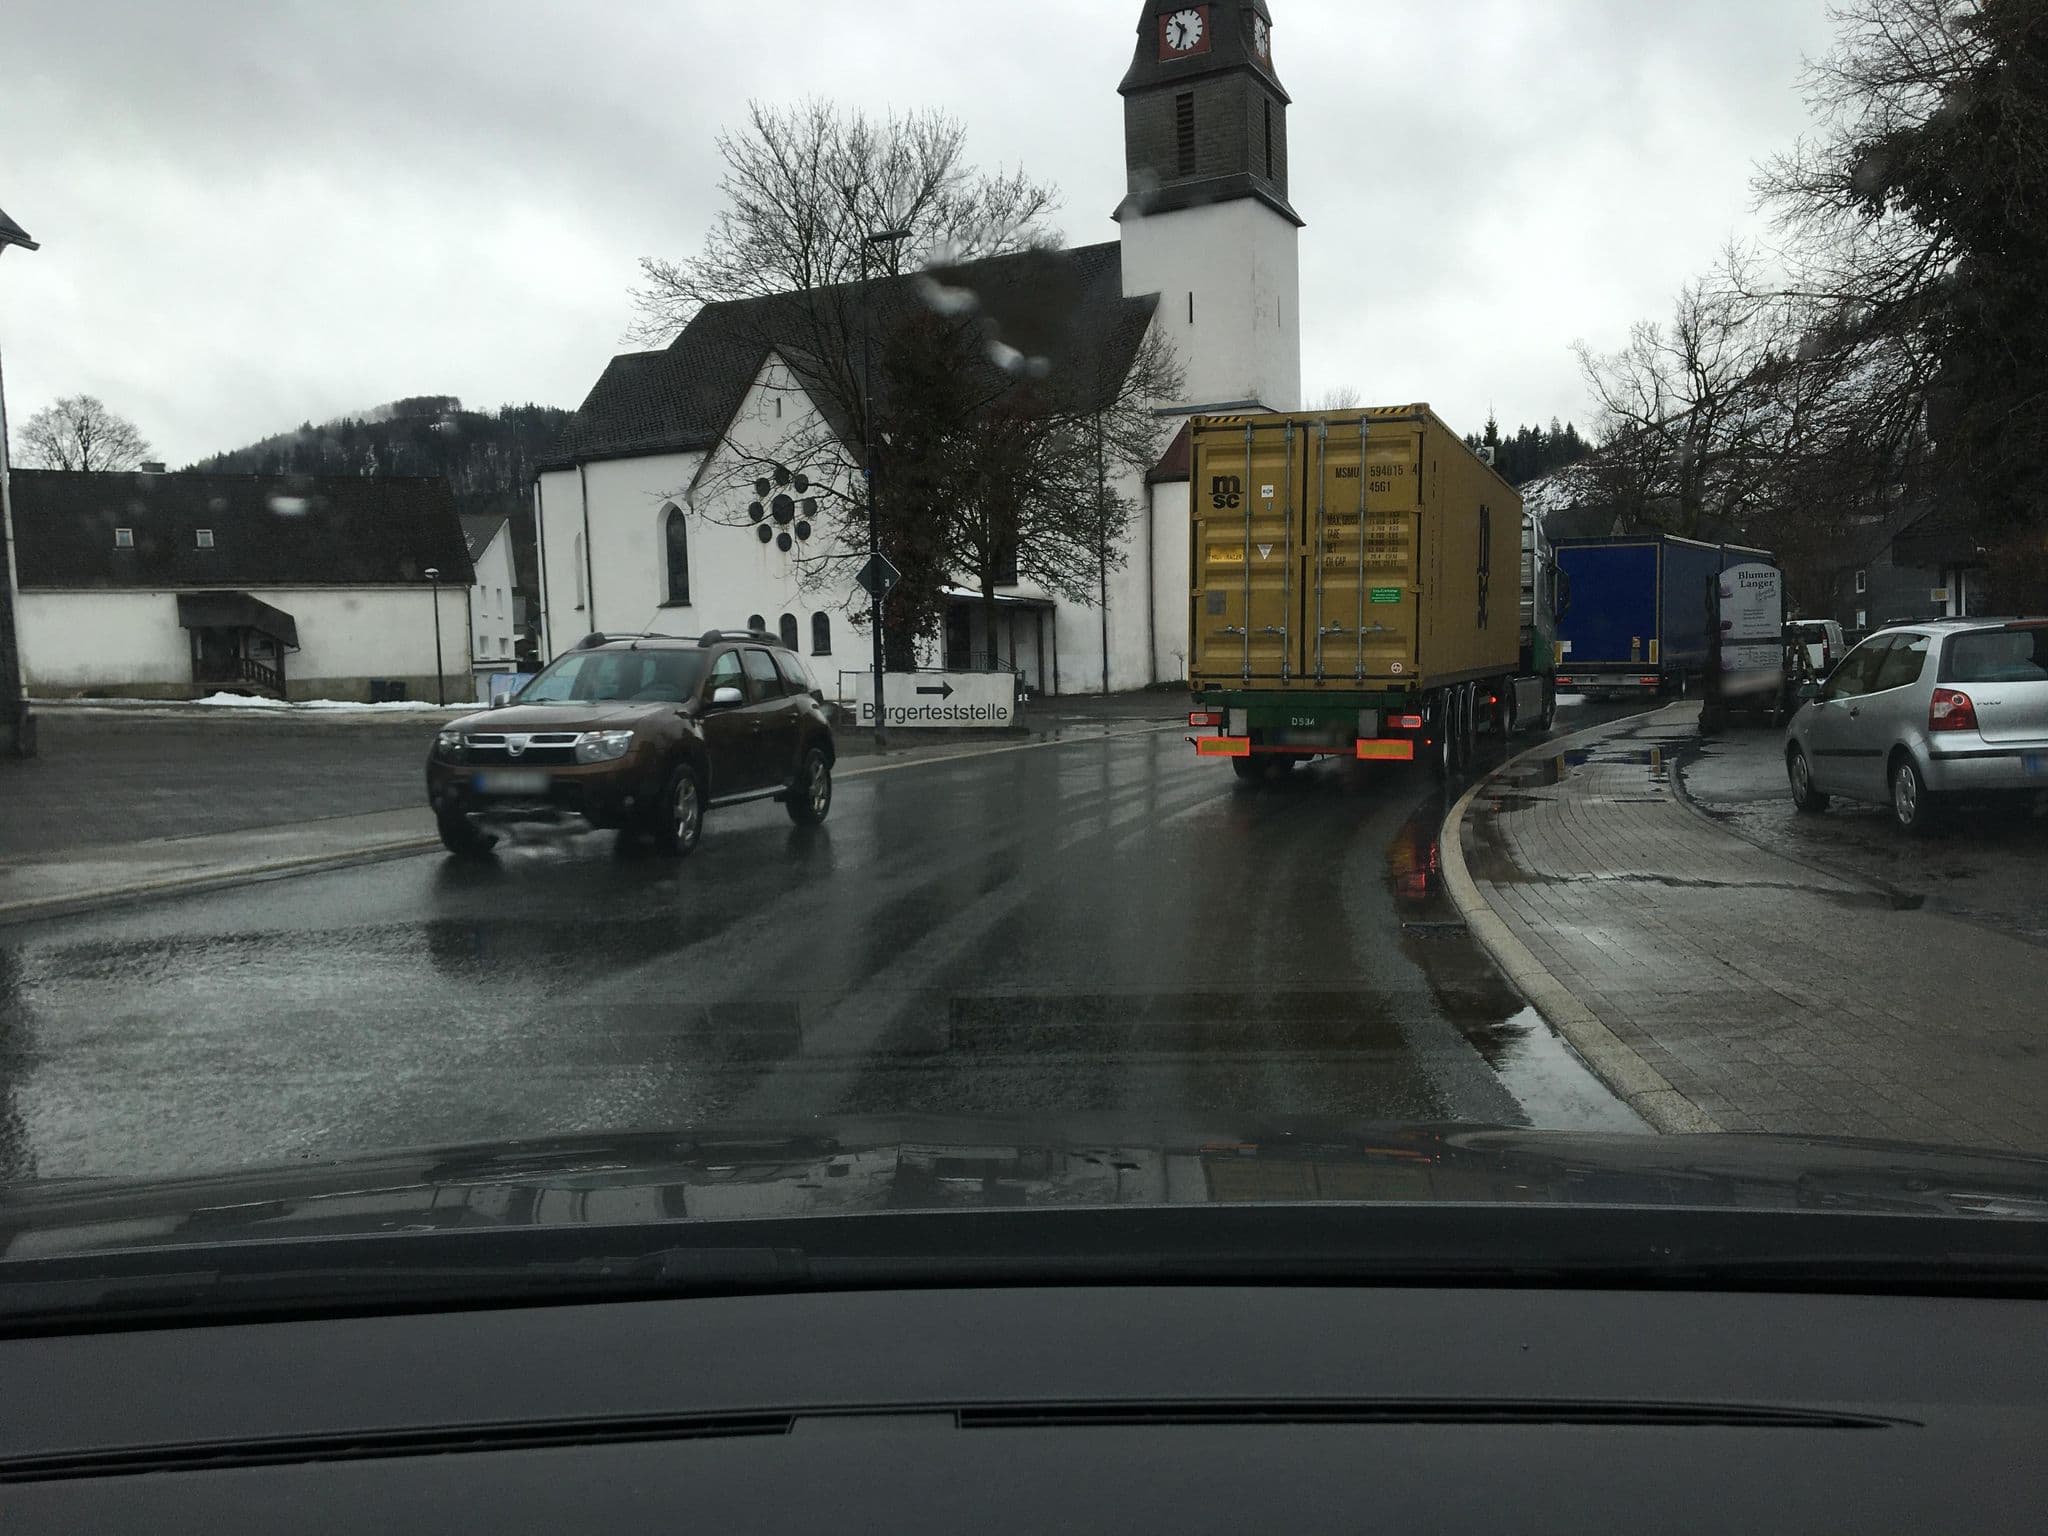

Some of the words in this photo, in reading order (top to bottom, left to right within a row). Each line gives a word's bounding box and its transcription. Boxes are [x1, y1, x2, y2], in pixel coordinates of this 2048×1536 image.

[1335, 466, 1360, 479] MSMU
[1369, 464, 1404, 478] 594015
[1369, 481, 1391, 493] 45G1
[1738, 570, 1776, 580] Blumen
[1740, 578, 1774, 590] Langer
[862, 703, 1008, 724] Brgerteststelle
